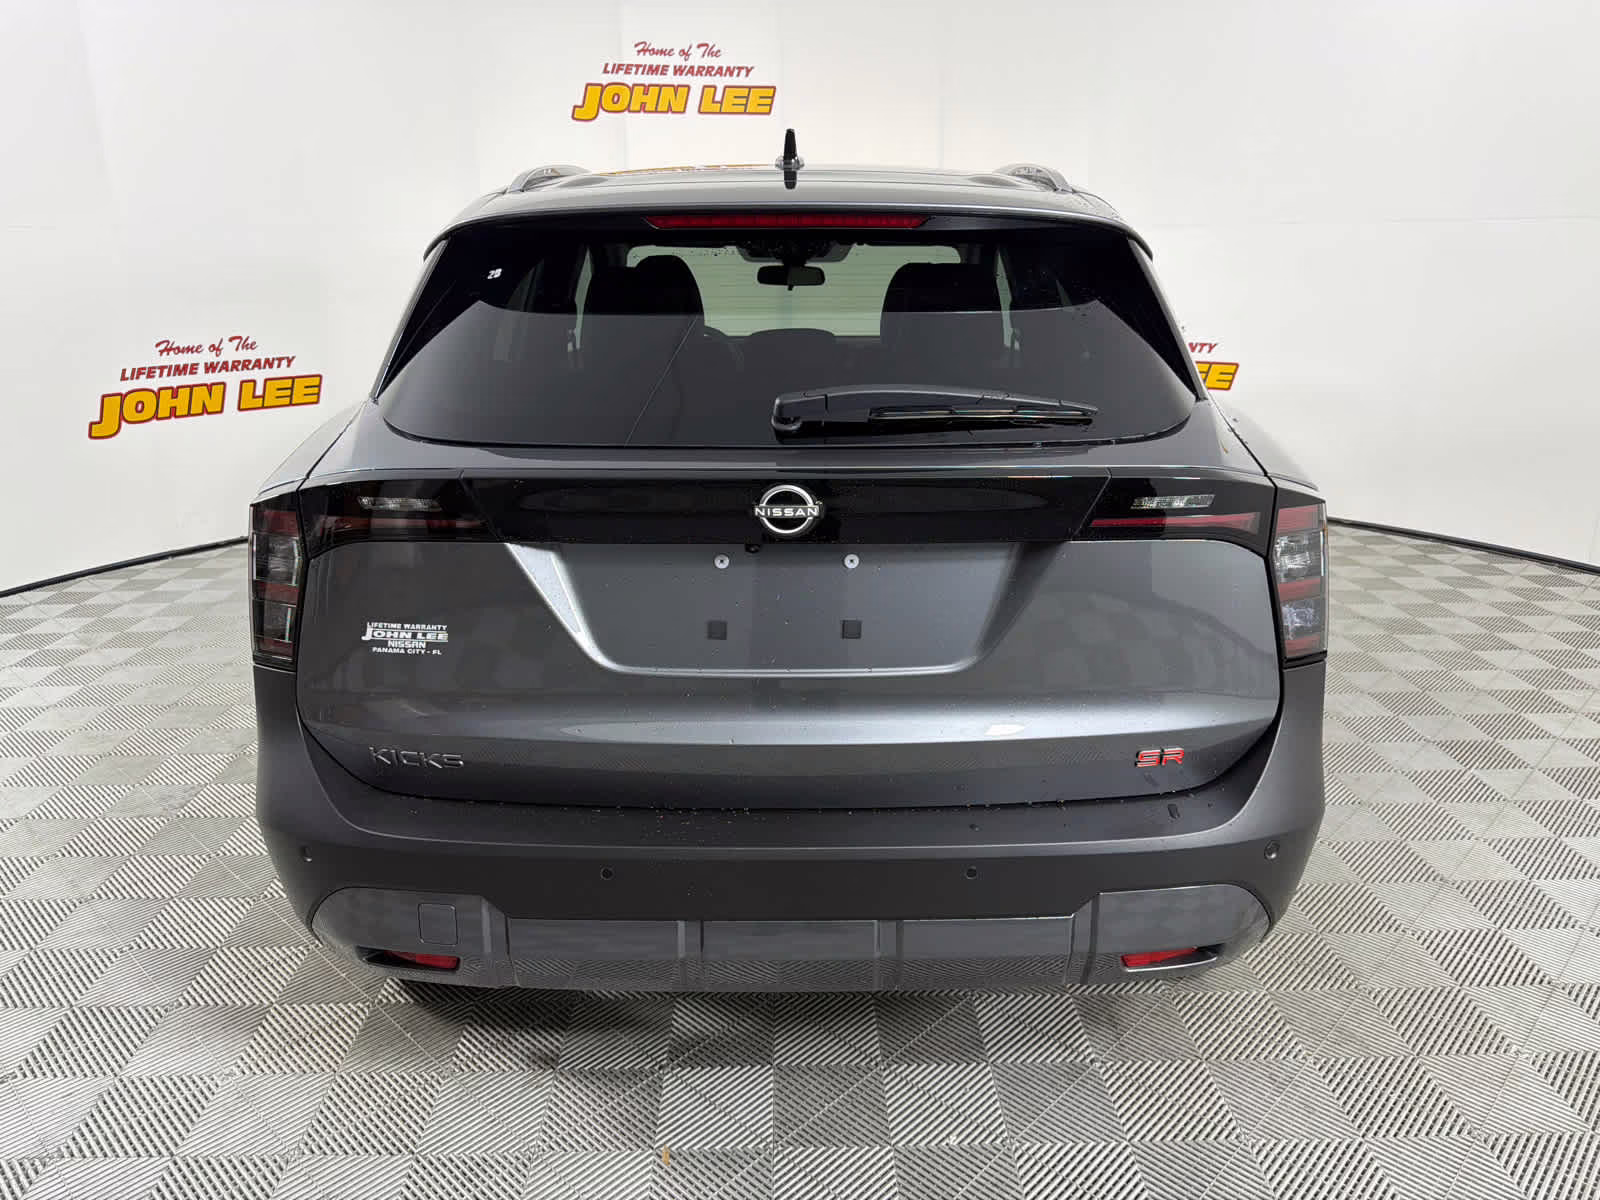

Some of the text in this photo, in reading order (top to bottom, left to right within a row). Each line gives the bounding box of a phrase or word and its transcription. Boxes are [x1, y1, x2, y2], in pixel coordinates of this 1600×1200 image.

[634, 41, 722, 61] Home of The
[602, 63, 754, 77] LIFETIME WARRANTY
[571, 82, 776, 122] JOHN LEE
[155, 336, 257, 357] Home of The
[120, 356, 296, 381] LIFETIME WARRANTY
[88, 374, 323, 440] JOHN LEE
[754, 507, 819, 517] NISSAN
[361, 627, 448, 640] JOHN LEE
[403, 623, 447, 631] WARRANTY
[387, 640, 426, 648] NISSAN
[369, 747, 464, 768] KICKS
[1137, 748, 1184, 767] SR
